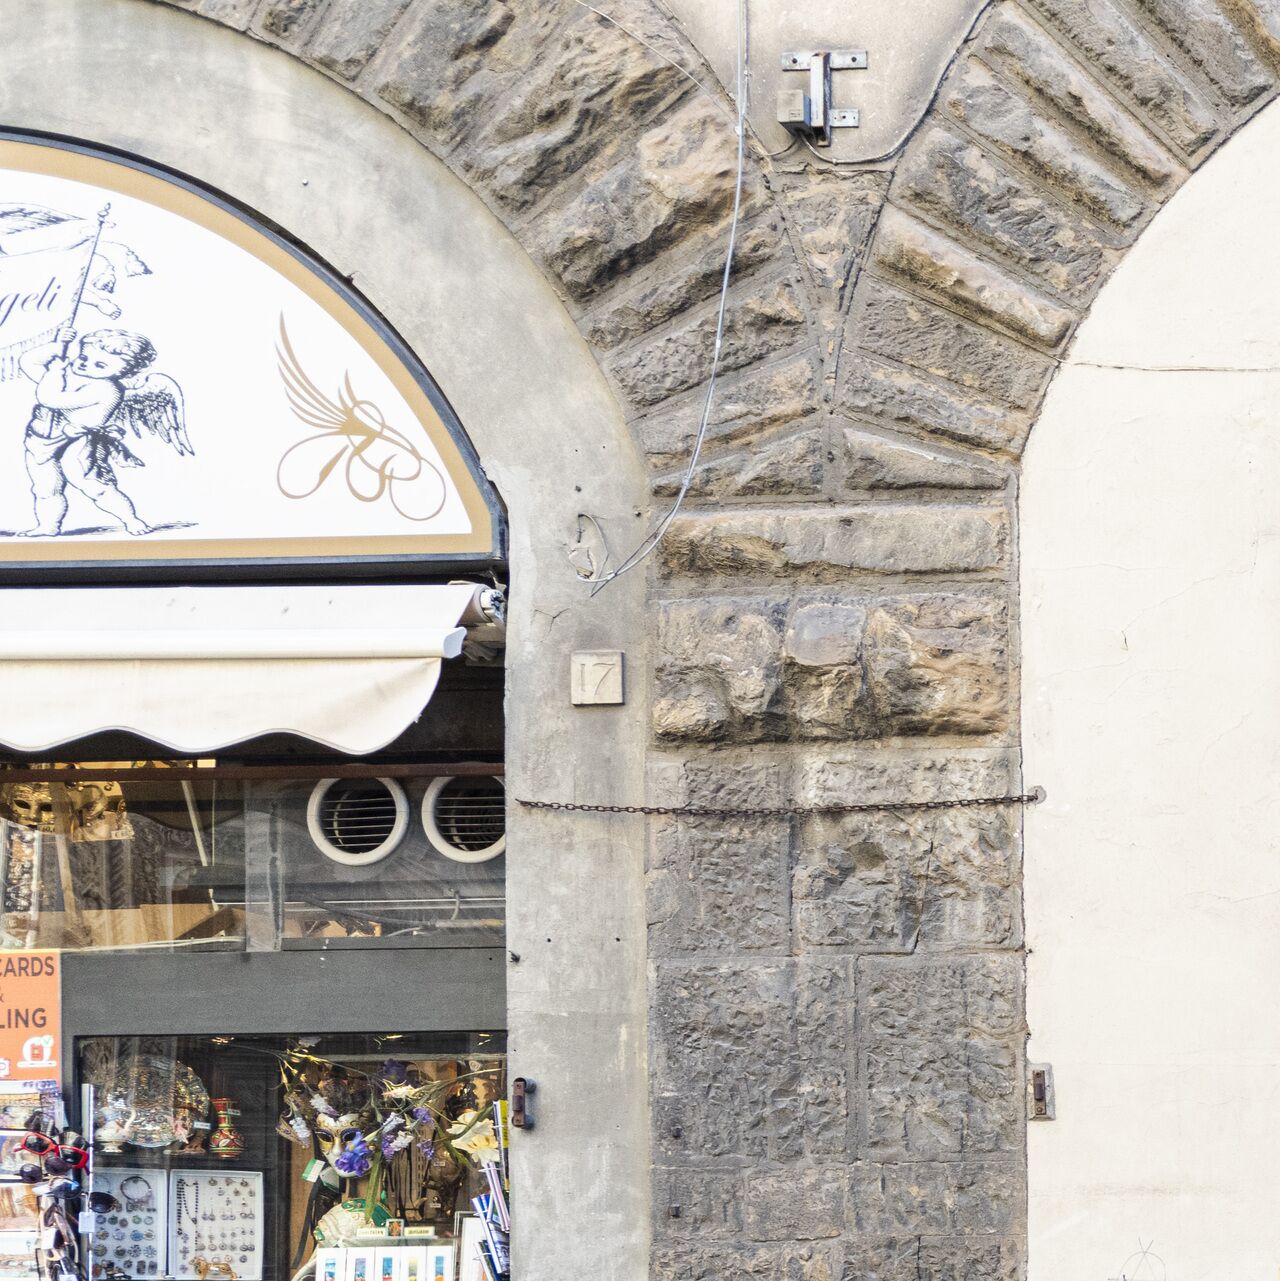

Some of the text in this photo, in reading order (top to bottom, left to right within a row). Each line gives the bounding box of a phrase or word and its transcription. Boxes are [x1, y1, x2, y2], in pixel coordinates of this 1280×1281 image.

[578, 662, 616, 698] 17
[0, 955, 55, 978] ARDS
[0, 1007, 47, 1029] ING
